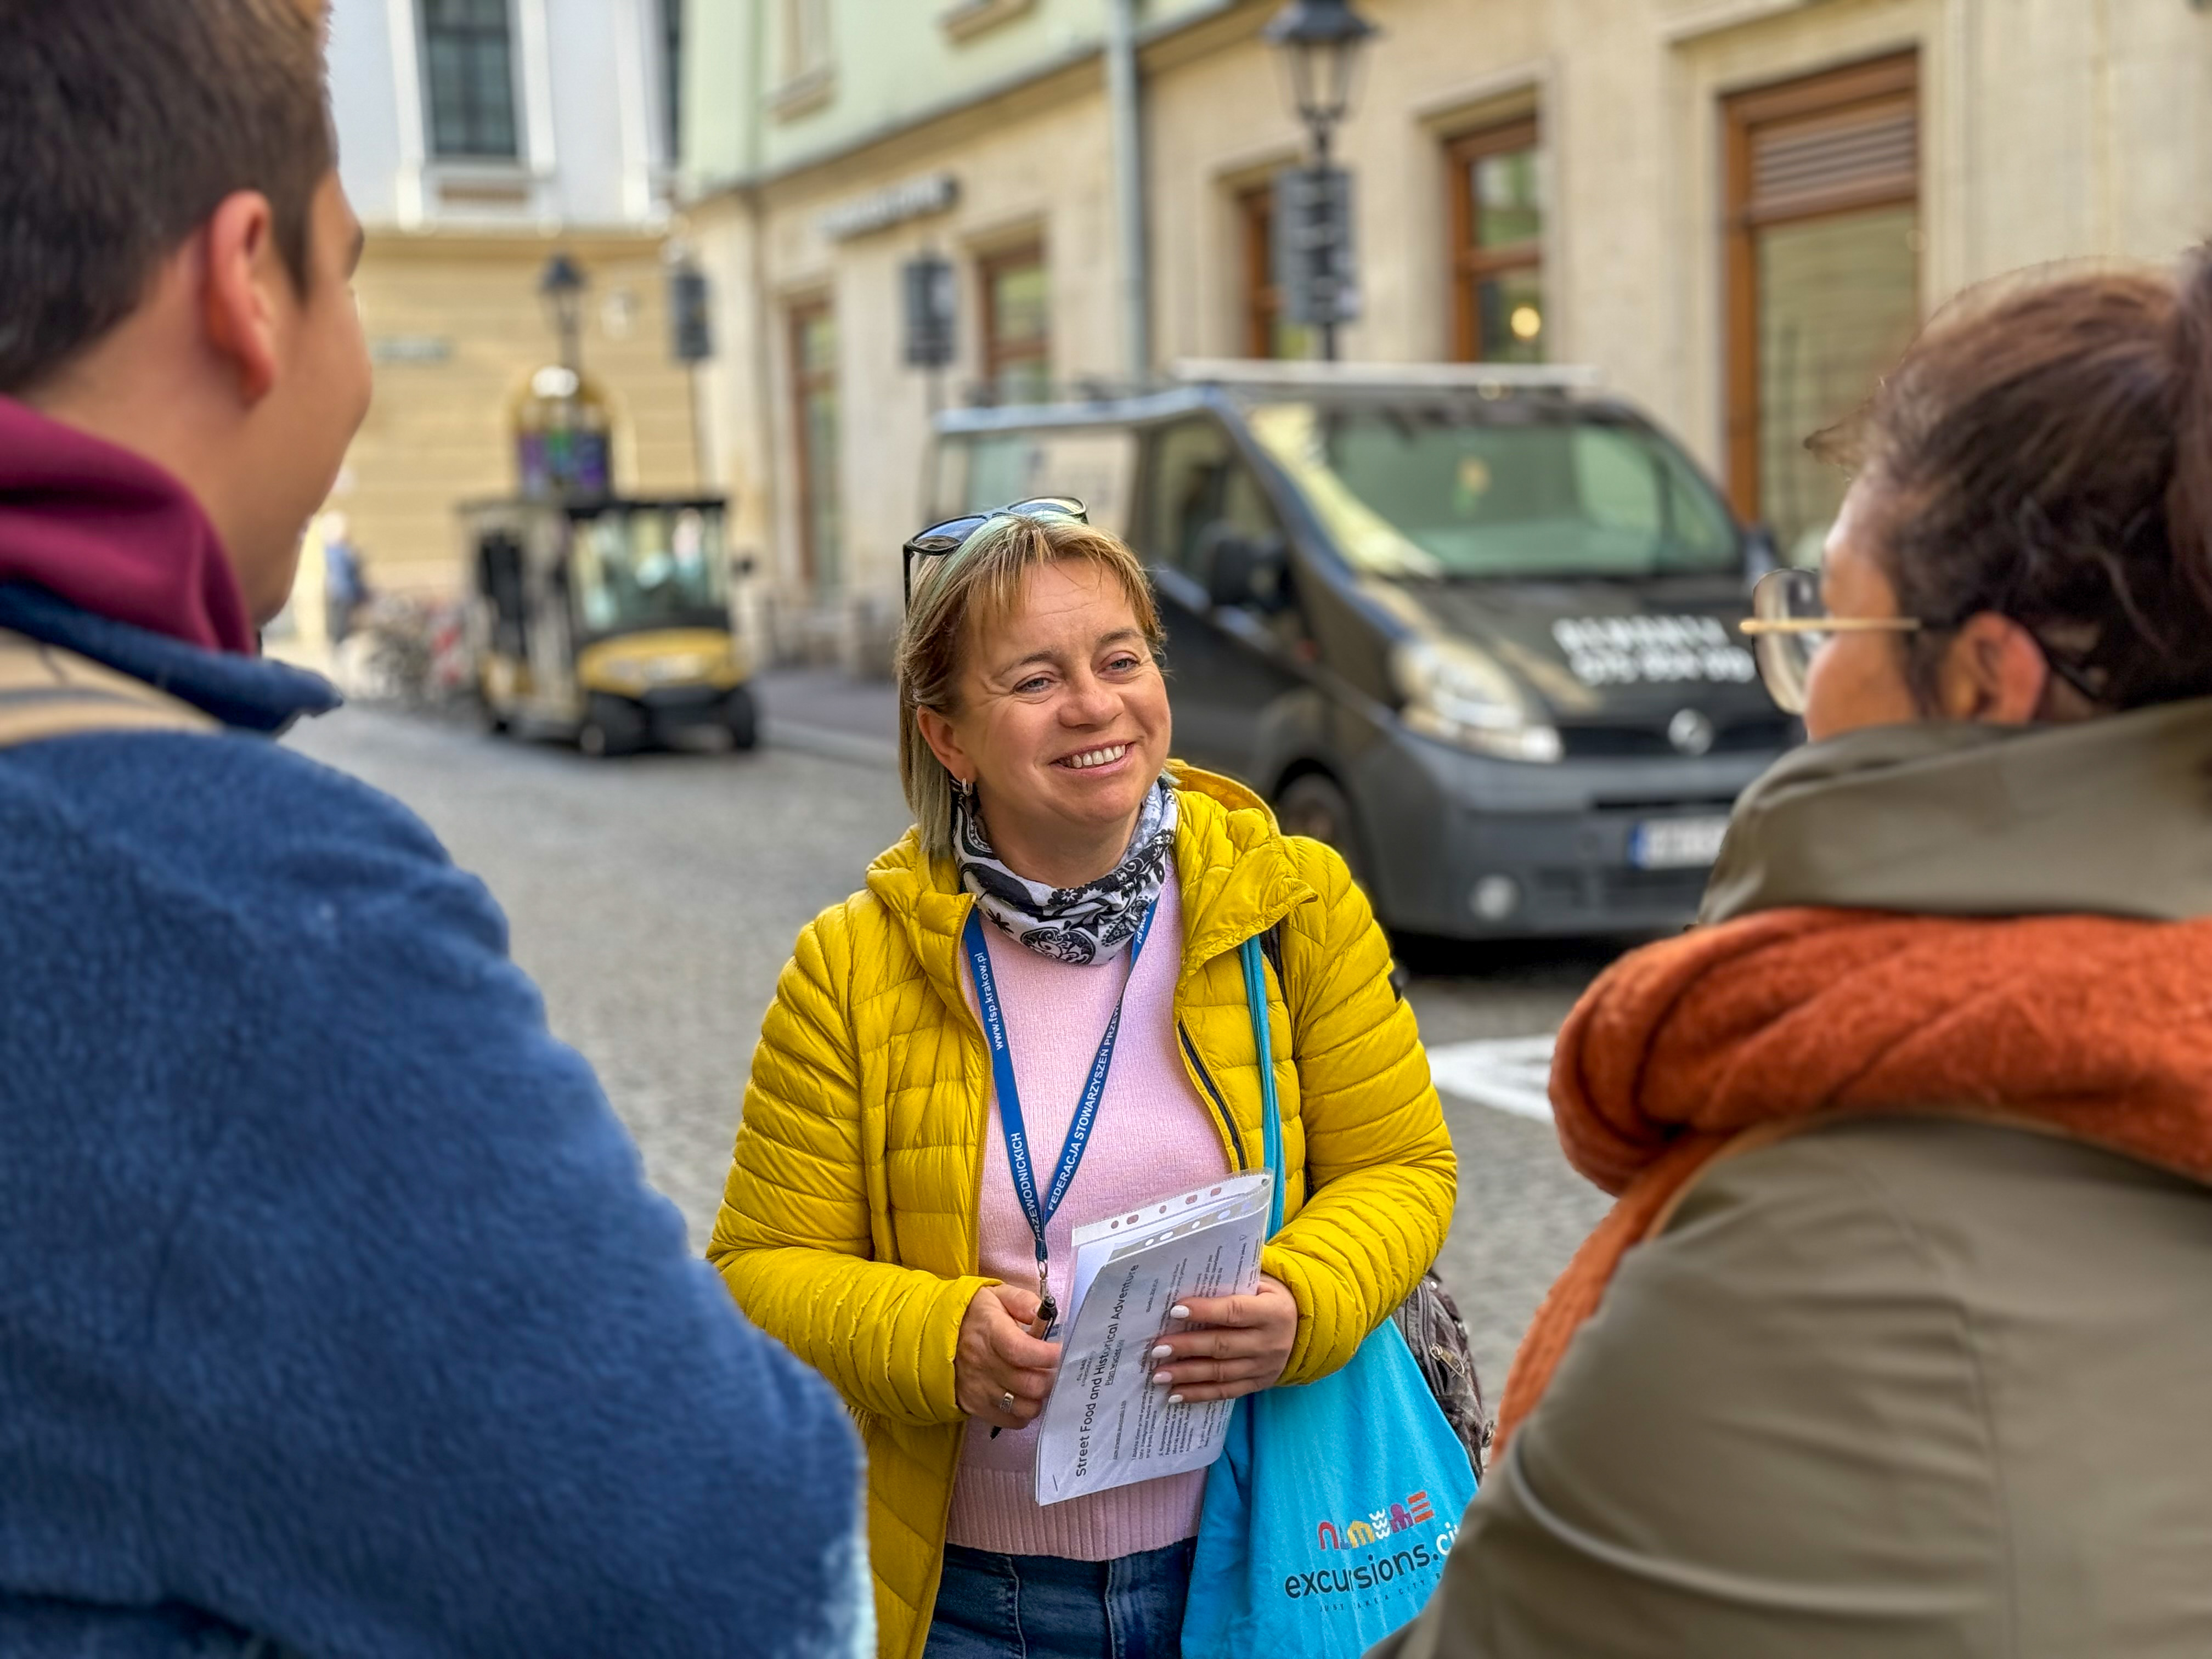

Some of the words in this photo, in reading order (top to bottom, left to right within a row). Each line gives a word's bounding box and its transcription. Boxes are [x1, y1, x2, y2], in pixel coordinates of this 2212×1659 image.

[974, 952, 1004, 1051] www.fsp.krakow.pl
[1048, 1142, 1082, 1211] FEDERACJA
[1074, 1048, 1109, 1141] STOWARZYSZEŃ
[1011, 1132, 1043, 1242] PRZEWODNICKICH
[1110, 1264, 1139, 1319] Adventure
[1093, 1323, 1119, 1376] Historical
[1090, 1378, 1103, 1400] and
[1080, 1402, 1097, 1433] Food
[1076, 1435, 1090, 1477] Street
[1352, 1597, 1379, 1609] AKE
